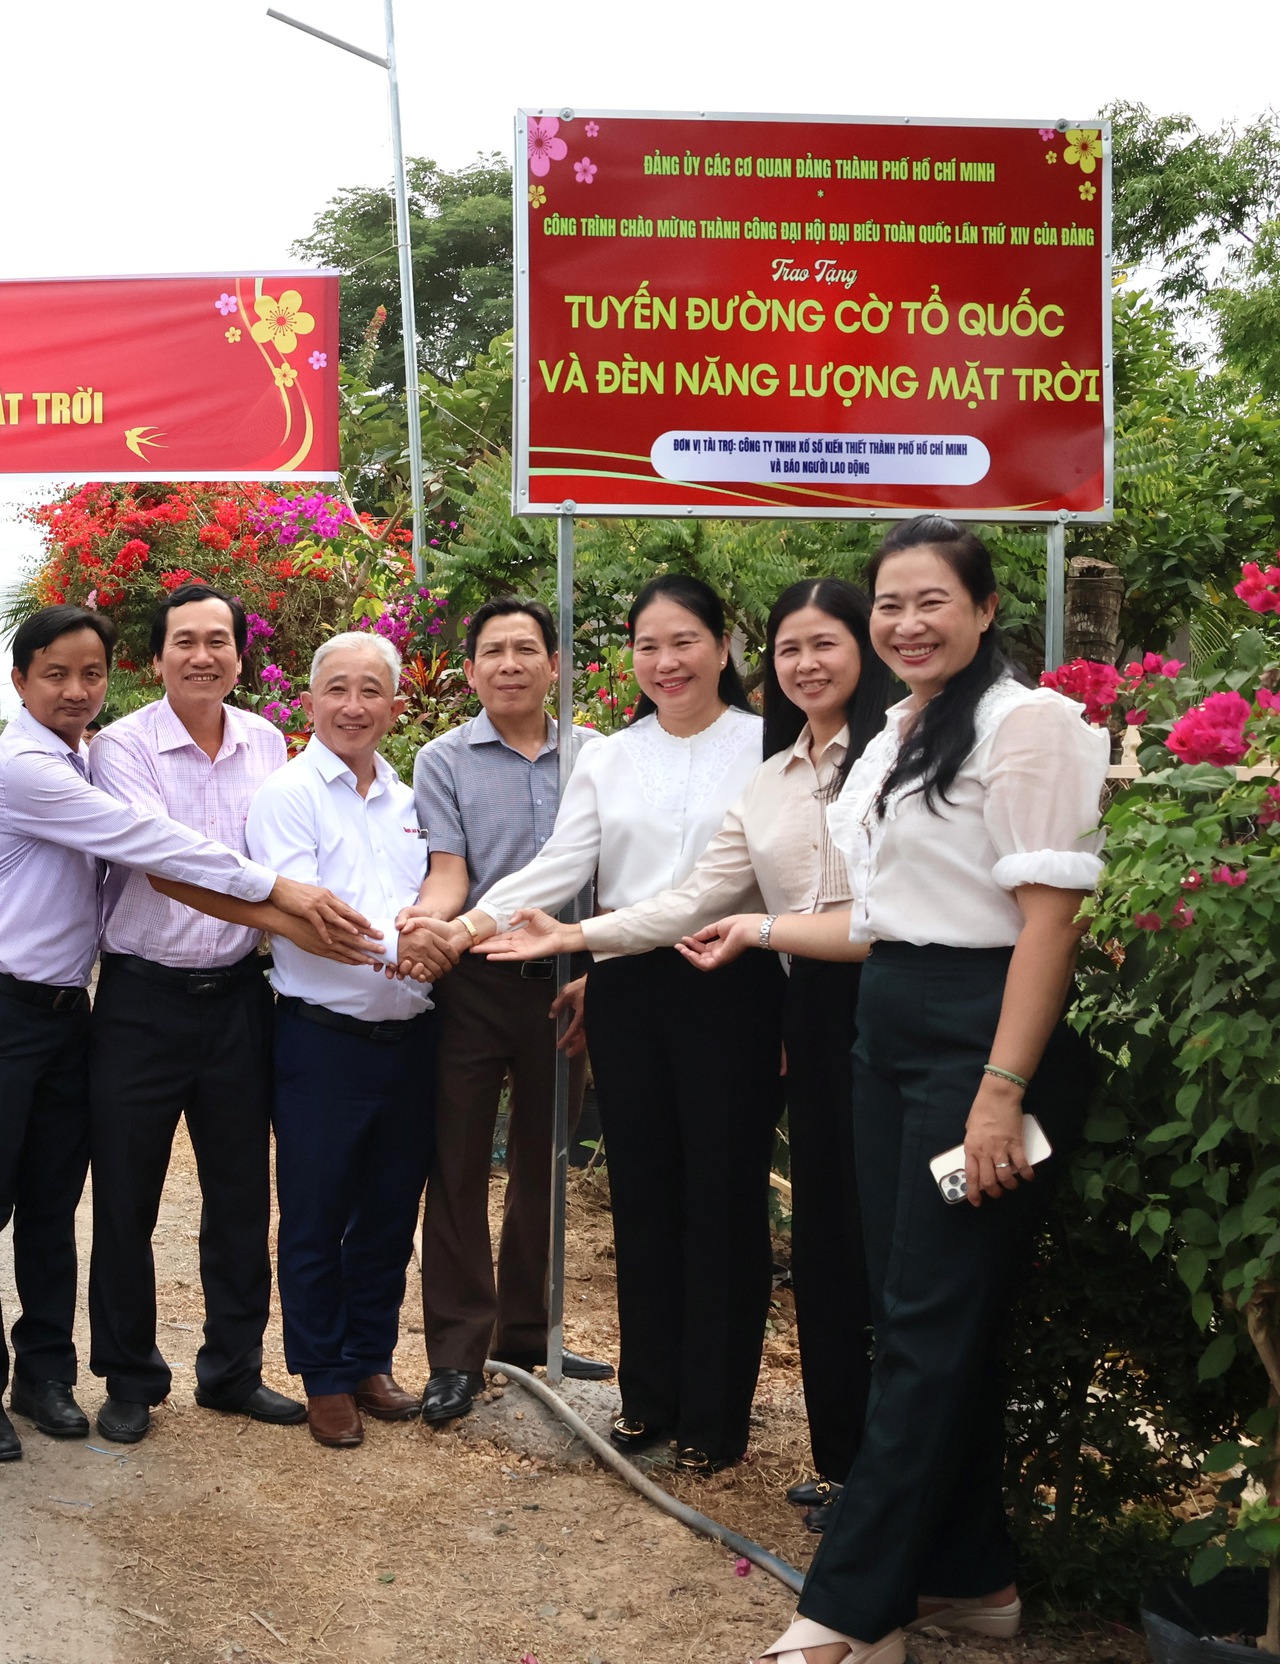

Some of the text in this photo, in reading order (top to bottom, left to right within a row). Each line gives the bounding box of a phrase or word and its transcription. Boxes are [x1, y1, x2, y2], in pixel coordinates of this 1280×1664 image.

[643, 149, 996, 183] ĐẢNG ỦY CÁC CƠ QUAN ĐẢNG THÀNH PHỐ HỒ CHÍ MINH
[543, 212, 1095, 247] CÔNG TRÌNH CHÀO MỪNG THÀNH CÔNG ĐẠI HỘI ĐẠI BIỂU TOÀN QUỐC LẦN THỨ XIV CỦA ĐẢNG
[771, 258, 810, 282] Trao
[564, 280, 1065, 337] TUYẾN ĐƯỜNG CỜ TỔ QUỐC
[538, 352, 1100, 409] VÀ ĐÈN NĂNG LƯỢNG MẶT TRỜI
[32, 385, 103, 424] TRỜI
[673, 438, 691, 452] ĐƠN
[693, 439, 701, 455] VỊ
[703, 436, 716, 452] TÀI
[718, 439, 736, 455] TRỢ:
[738, 437, 761, 452] CÔNG
[763, 440, 773, 453] TY
[775, 440, 796, 453] TNHH
[812, 438, 824, 453] SỐ
[825, 439, 843, 454] KIẾN
[845, 439, 867, 454] THIẾT
[869, 439, 895, 455] THÀNH
[898, 440, 915, 455] PHỐ
[930, 440, 944, 456] CHÍ
[945, 443, 968, 456] MINH
[770, 458, 870, 477] VÀ BÁO NGƯỜI LAO ĐỘNG
